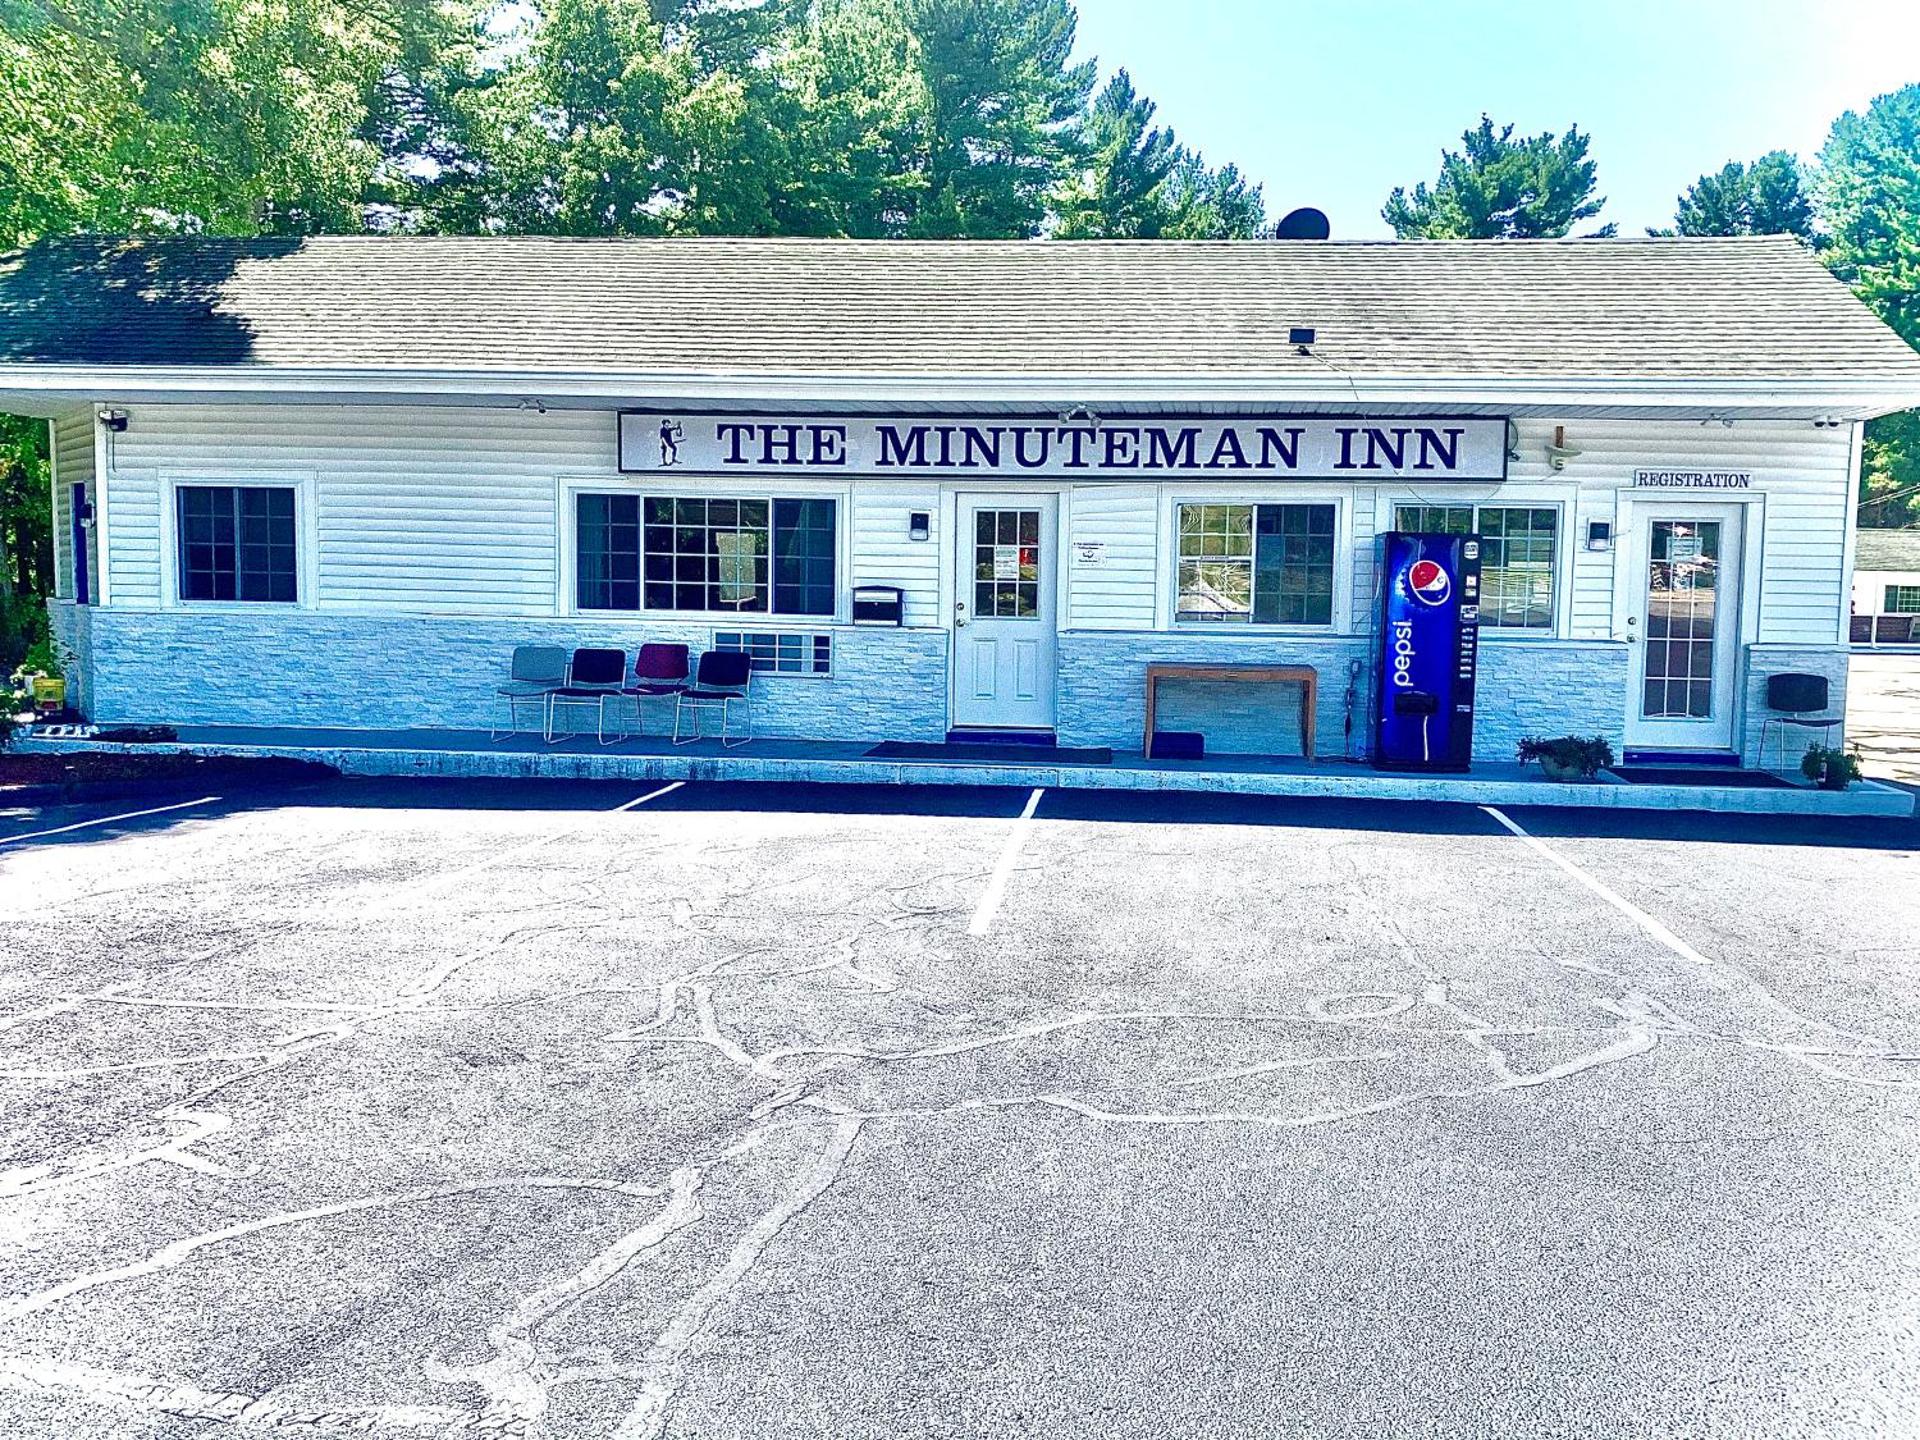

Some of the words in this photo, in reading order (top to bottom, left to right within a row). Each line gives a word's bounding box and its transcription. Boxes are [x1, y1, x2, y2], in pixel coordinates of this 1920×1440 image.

[717, 423, 847, 465] THE
[875, 425, 1305, 469] MINUTEMAN
[1333, 428, 1465, 470] INN
[1638, 471, 1751, 488] REGISTRATION
[1392, 620, 1416, 687] pepsi
